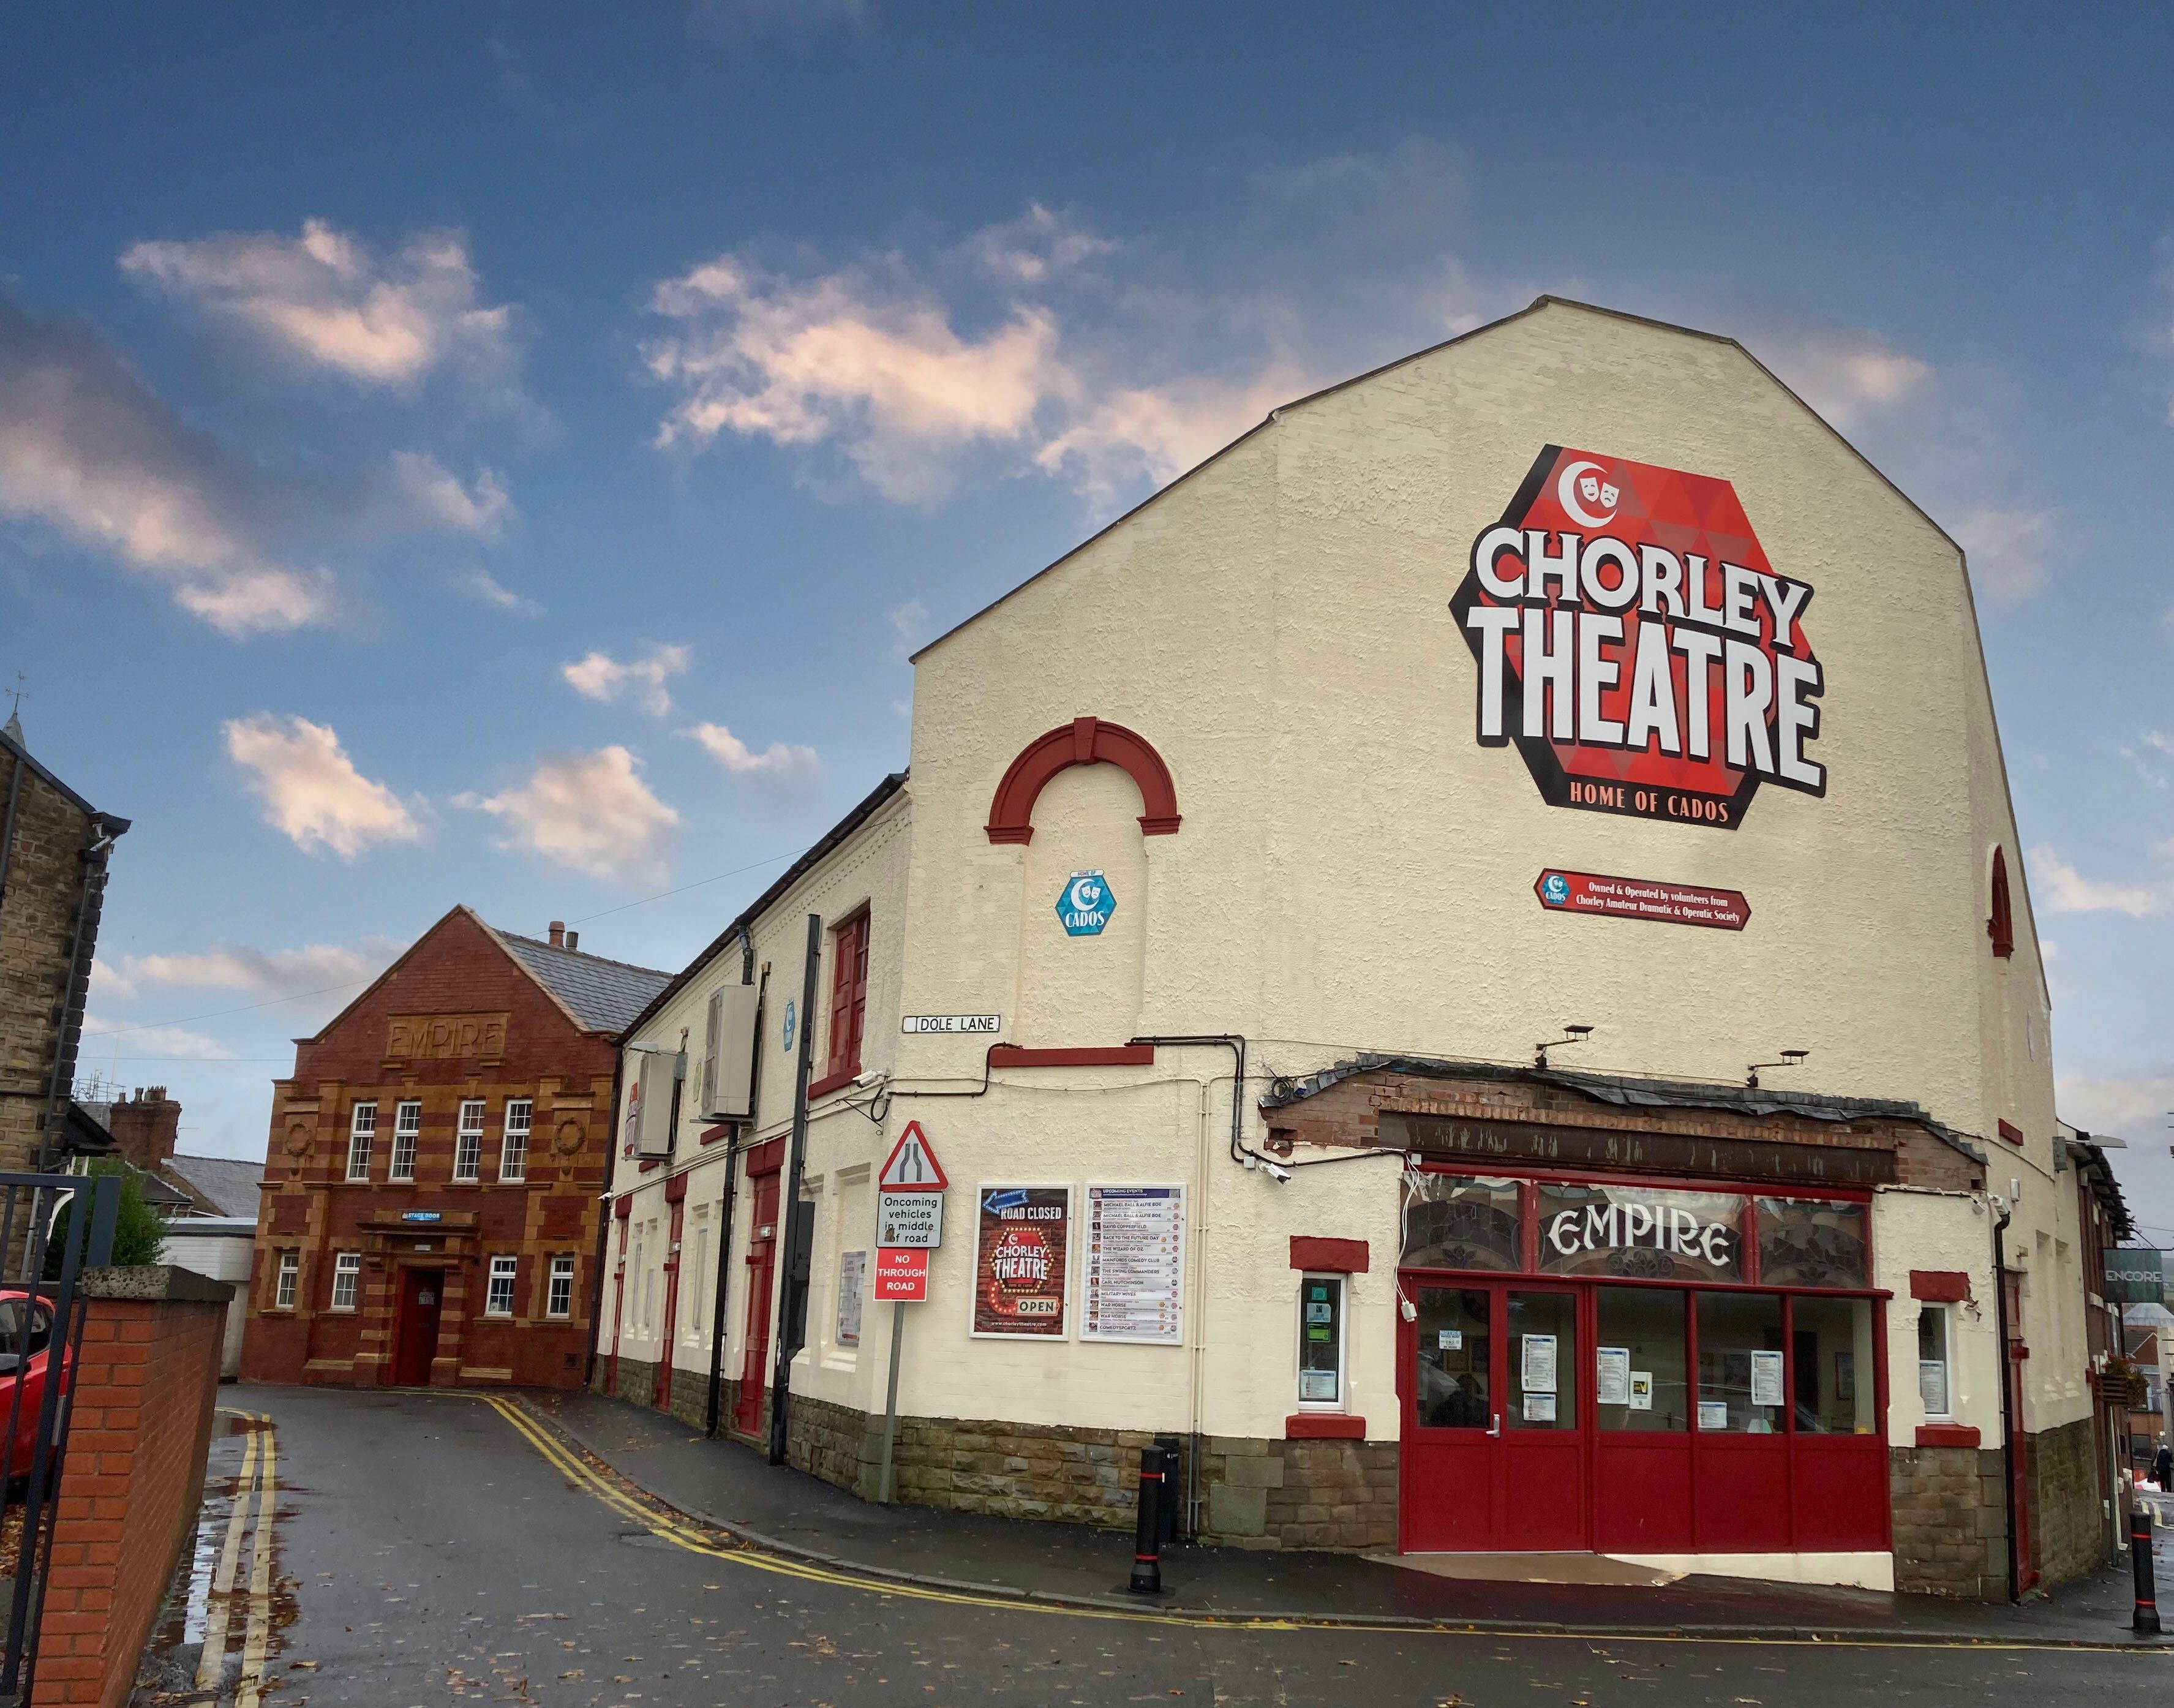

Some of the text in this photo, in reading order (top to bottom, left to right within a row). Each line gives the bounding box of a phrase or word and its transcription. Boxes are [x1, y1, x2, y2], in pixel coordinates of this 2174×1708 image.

[1475, 527, 1810, 647] CHORLEY
[1467, 606, 1821, 787] THEATRE
[1569, 781, 1728, 822] HOME OF CADOS
[1546, 892, 1566, 901] CADOS
[1589, 882, 1728, 907] Owned & Operated by volunteers from
[1576, 895, 1740, 924] Chorley Amateur Dramatic & Operatic Society
[1065, 910, 1105, 928] CADOS
[920, 1017, 995, 1031] DOLE LANE
[389, 1021, 502, 1057] EMPIRE
[884, 1197, 938, 1208] Oncoming
[889, 1210, 931, 1219] vehicles
[1001, 1206, 1062, 1220] ROAD CLOSED
[885, 1221, 934, 1231] in middle
[905, 1233, 928, 1243] road
[1548, 1203, 1731, 1266] EMPIRE
[995, 1245, 1047, 1258] CHORLEY
[895, 1255, 910, 1264] NO
[878, 1268, 926, 1277] THROUGH
[995, 1257, 1048, 1281] THEATRE
[2105, 1270, 2163, 1282] ENCORE
[886, 1282, 915, 1290] ROAD
[1019, 1301, 1054, 1312] OPEN
